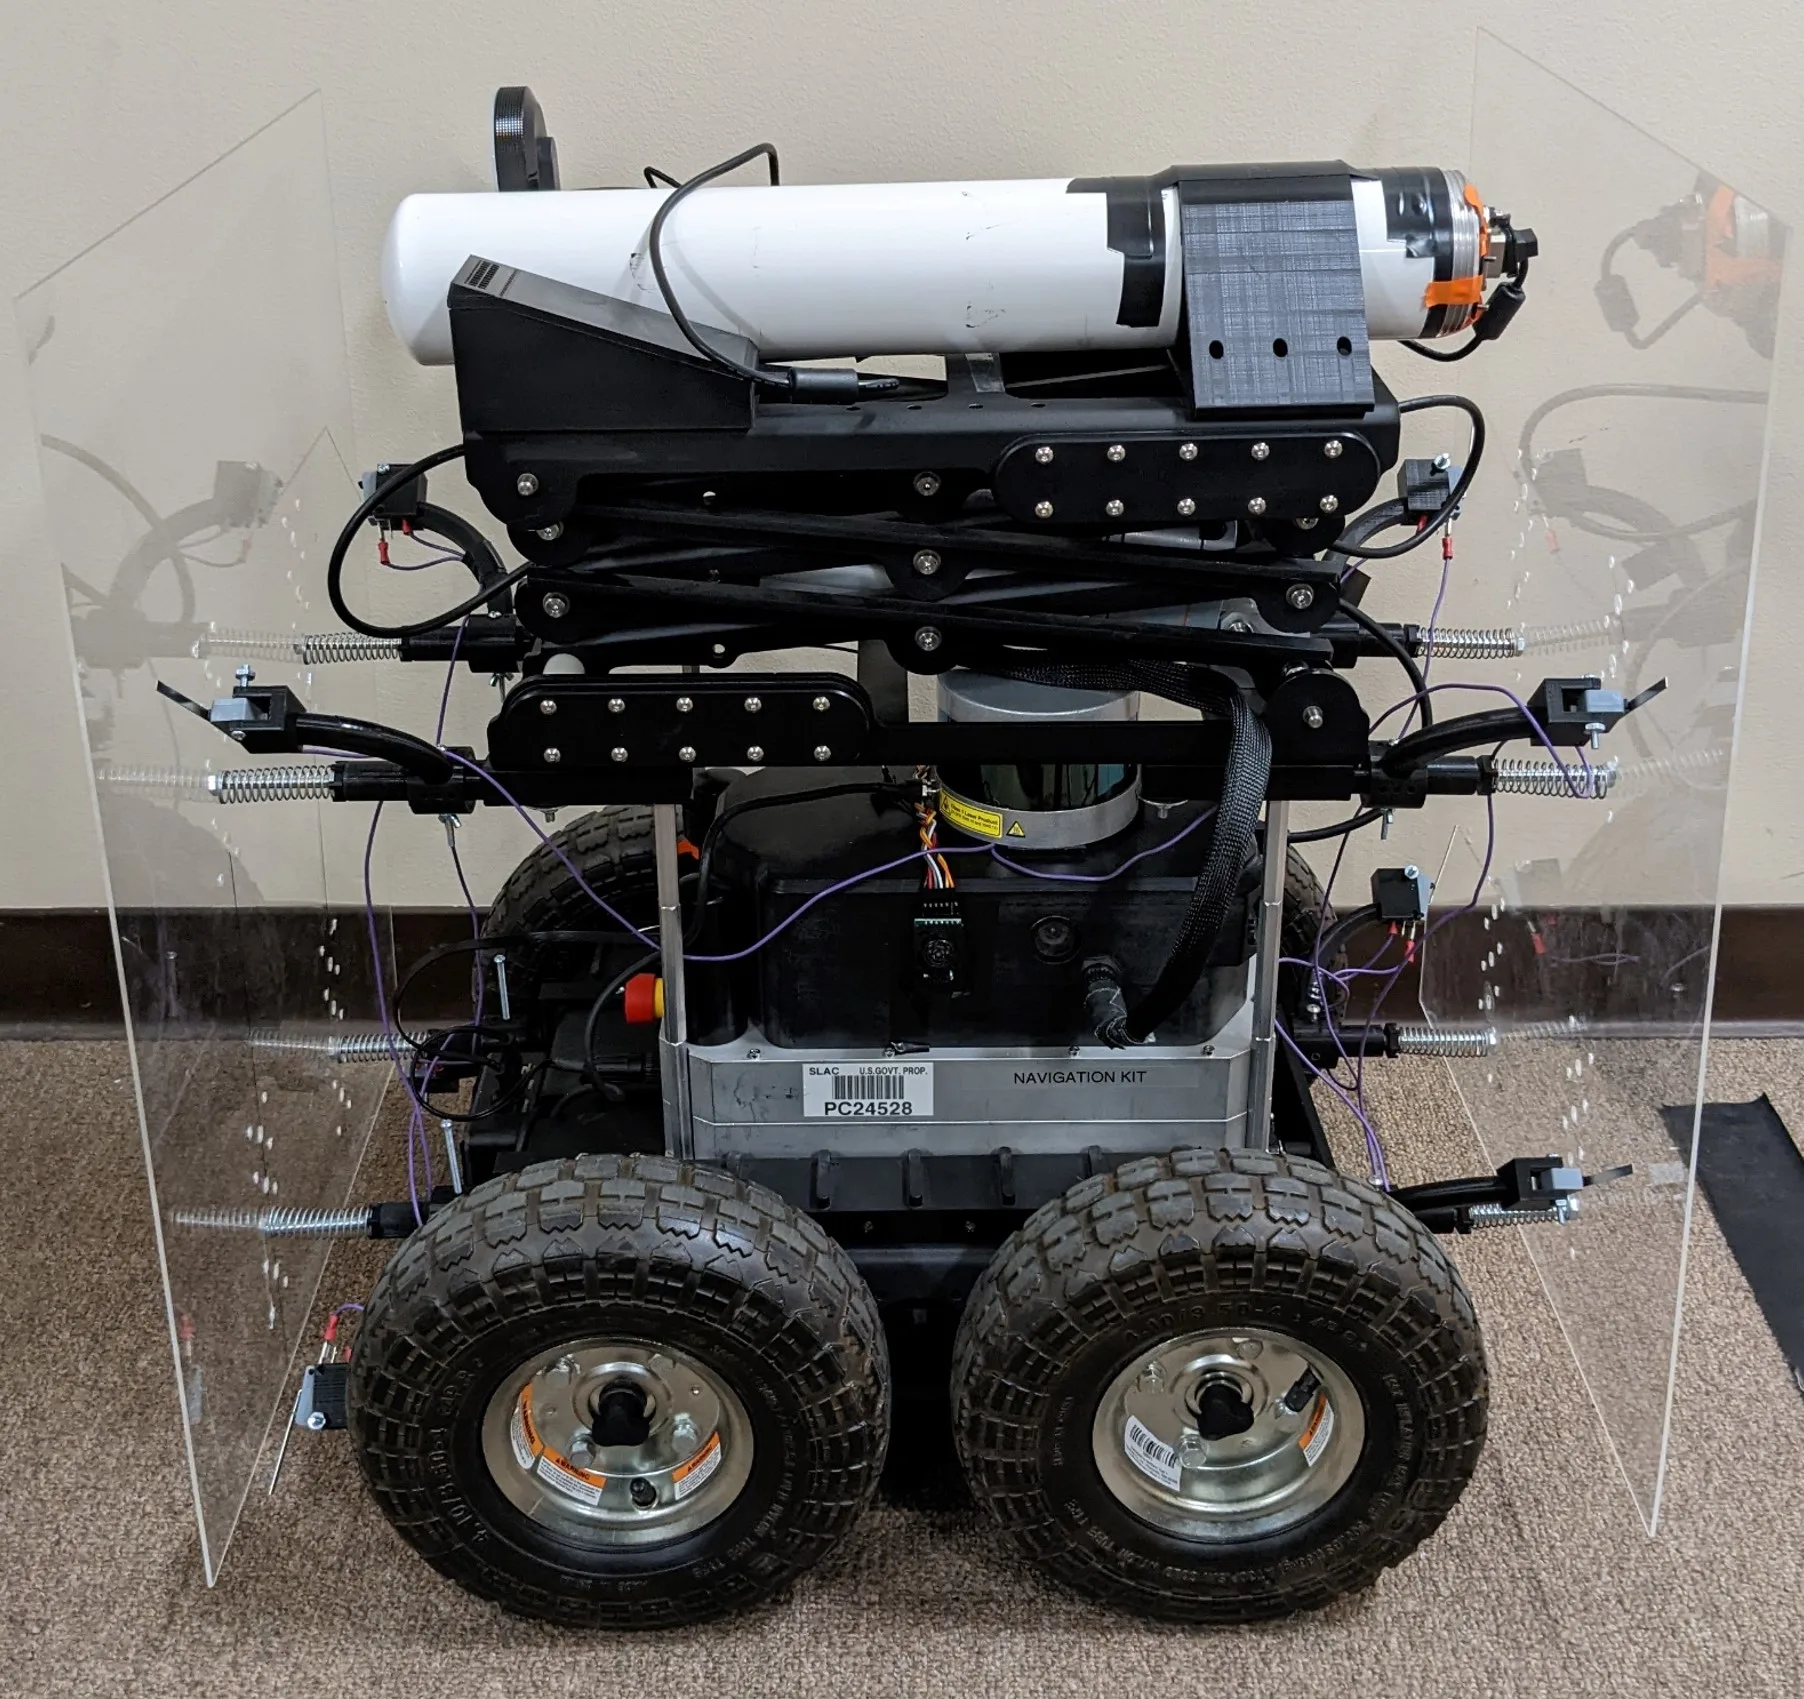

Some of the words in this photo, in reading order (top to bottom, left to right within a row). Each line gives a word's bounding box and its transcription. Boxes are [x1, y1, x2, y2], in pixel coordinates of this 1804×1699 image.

[809, 1067, 840, 1075] SLAC
[903, 1066, 928, 1075] PROP.
[1014, 1071, 1116, 1084] NAVIGATION
[1120, 1070, 1147, 1083] KIT
[824, 1101, 912, 1116] PC24528
[559, 1456, 591, 1481] WARNING
